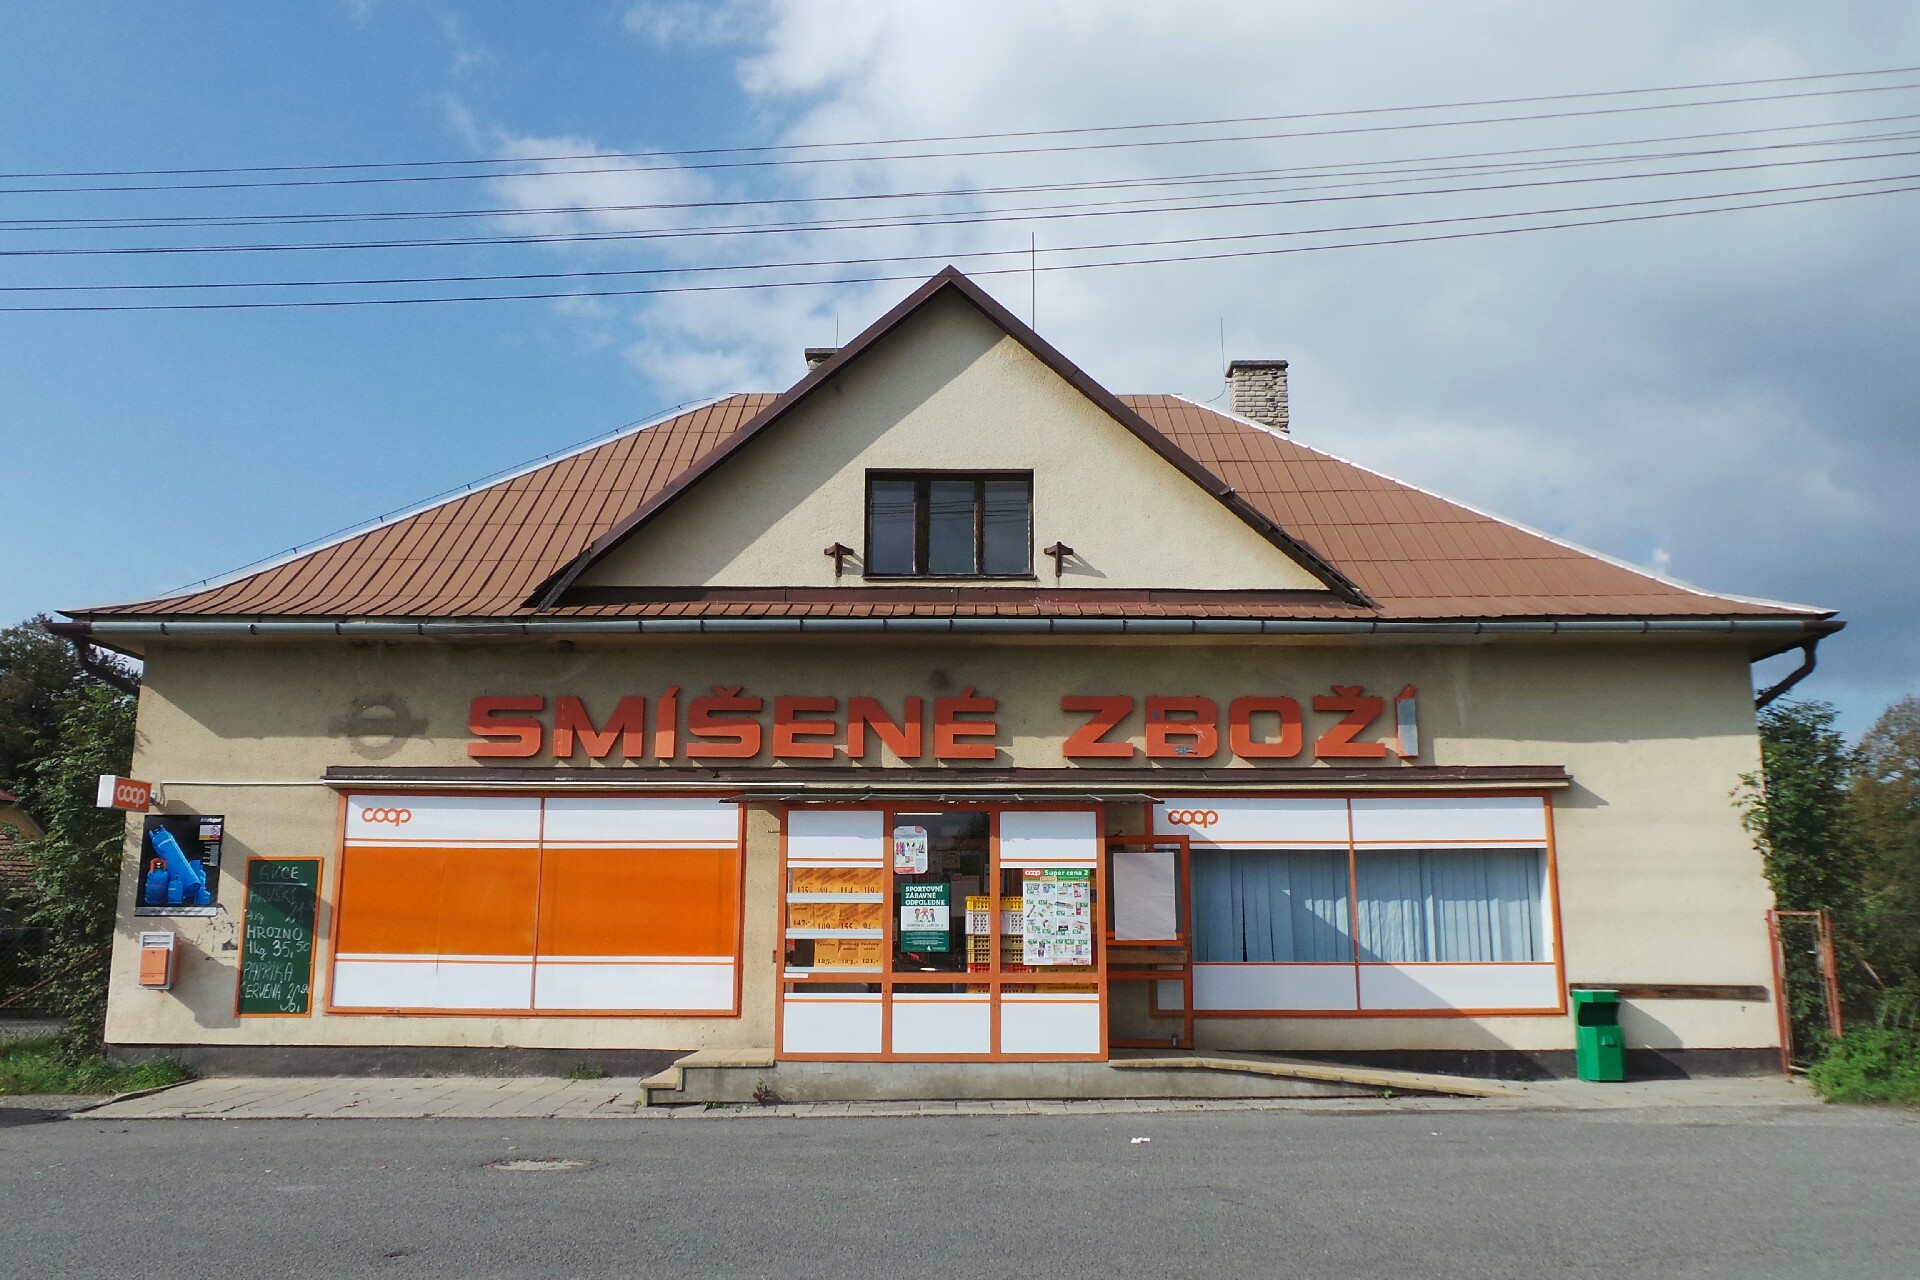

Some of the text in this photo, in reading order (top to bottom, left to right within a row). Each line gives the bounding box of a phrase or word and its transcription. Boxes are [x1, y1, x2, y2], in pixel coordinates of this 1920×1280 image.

[466, 684, 1420, 759] SMÍŠENÉ ZBOŽÍ
[117, 784, 146, 808] coop
[361, 807, 412, 827] coop
[1167, 808, 1219, 828] coop
[1044, 869, 1065, 877] Super
[246, 924, 303, 940] HROZNO
[243, 961, 294, 981] PAPRIKA
